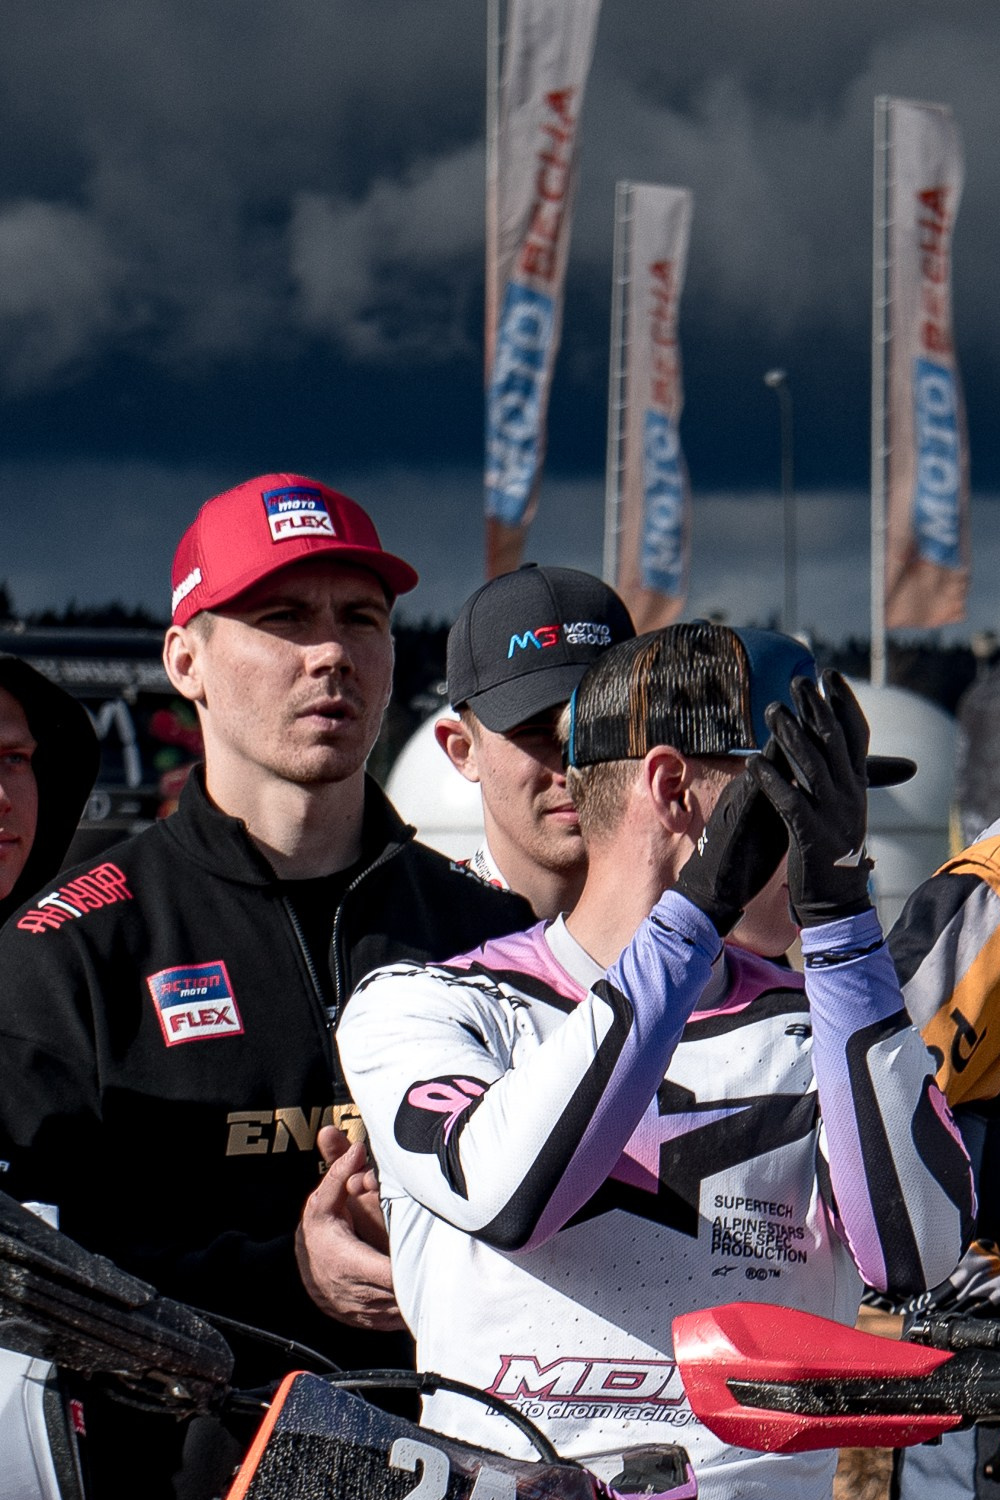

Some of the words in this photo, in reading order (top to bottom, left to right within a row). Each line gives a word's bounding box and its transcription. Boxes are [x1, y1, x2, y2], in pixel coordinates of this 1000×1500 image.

[274, 515, 333, 534] FLEX
[566, 634, 612, 646] GROUP
[160, 974, 221, 995] ACTION
[169, 1005, 237, 1034] FLEX
[714, 1194, 793, 1218] SUPERTECH
[712, 1215, 805, 1239] ALPINESTARS
[712, 1228, 753, 1245] RACE
[756, 1232, 792, 1250] SPEC
[711, 1241, 808, 1264] PRODUCTION
[547, 1402, 614, 1419] drom
[615, 1403, 694, 1427] racing
